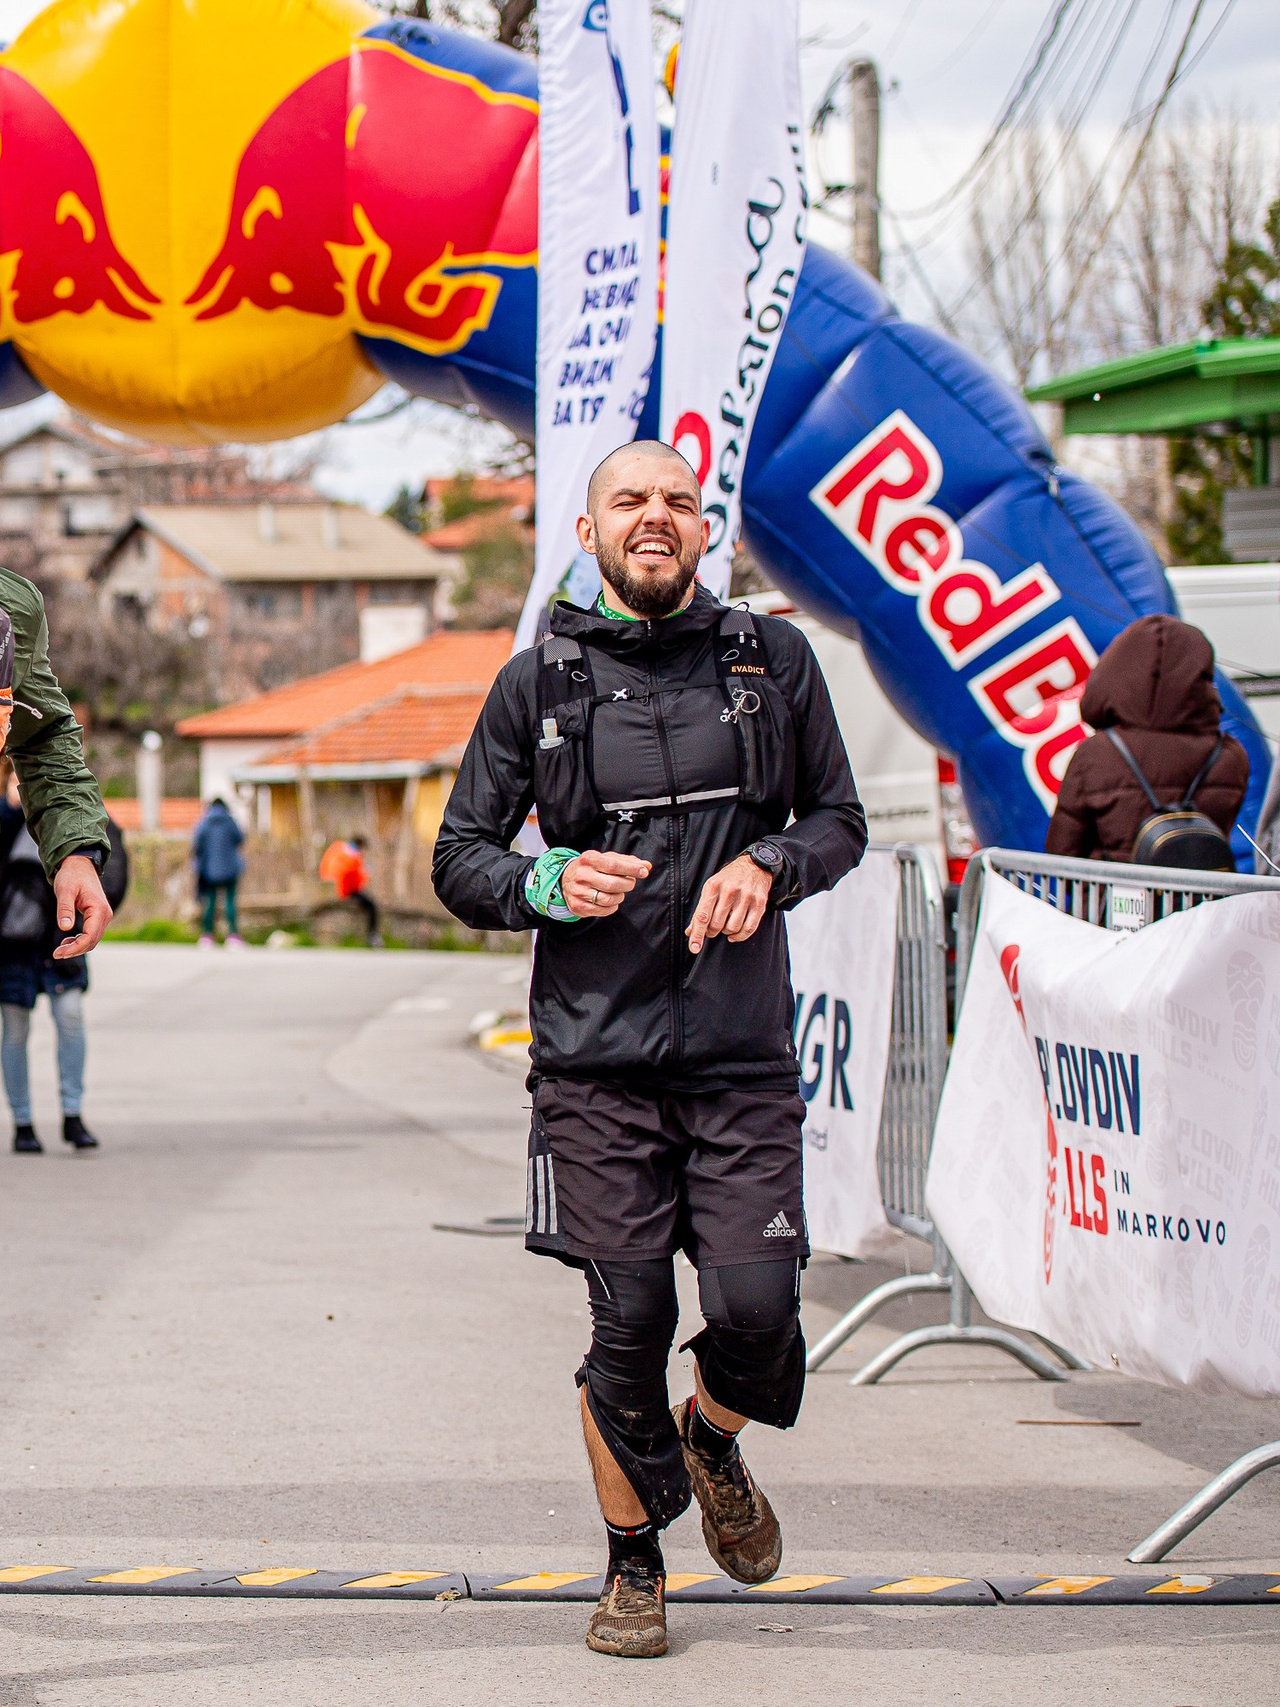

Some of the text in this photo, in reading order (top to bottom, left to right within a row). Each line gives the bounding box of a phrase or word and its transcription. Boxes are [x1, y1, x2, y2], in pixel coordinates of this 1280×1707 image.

[817, 418, 1052, 662] Red
[731, 664, 766, 675] EVADICT
[794, 992, 855, 1111] GR
[1061, 1146, 1131, 1236] LLS IN
[762, 1226, 797, 1238] adidas
[1116, 1208, 1227, 1247] MARKOVO
